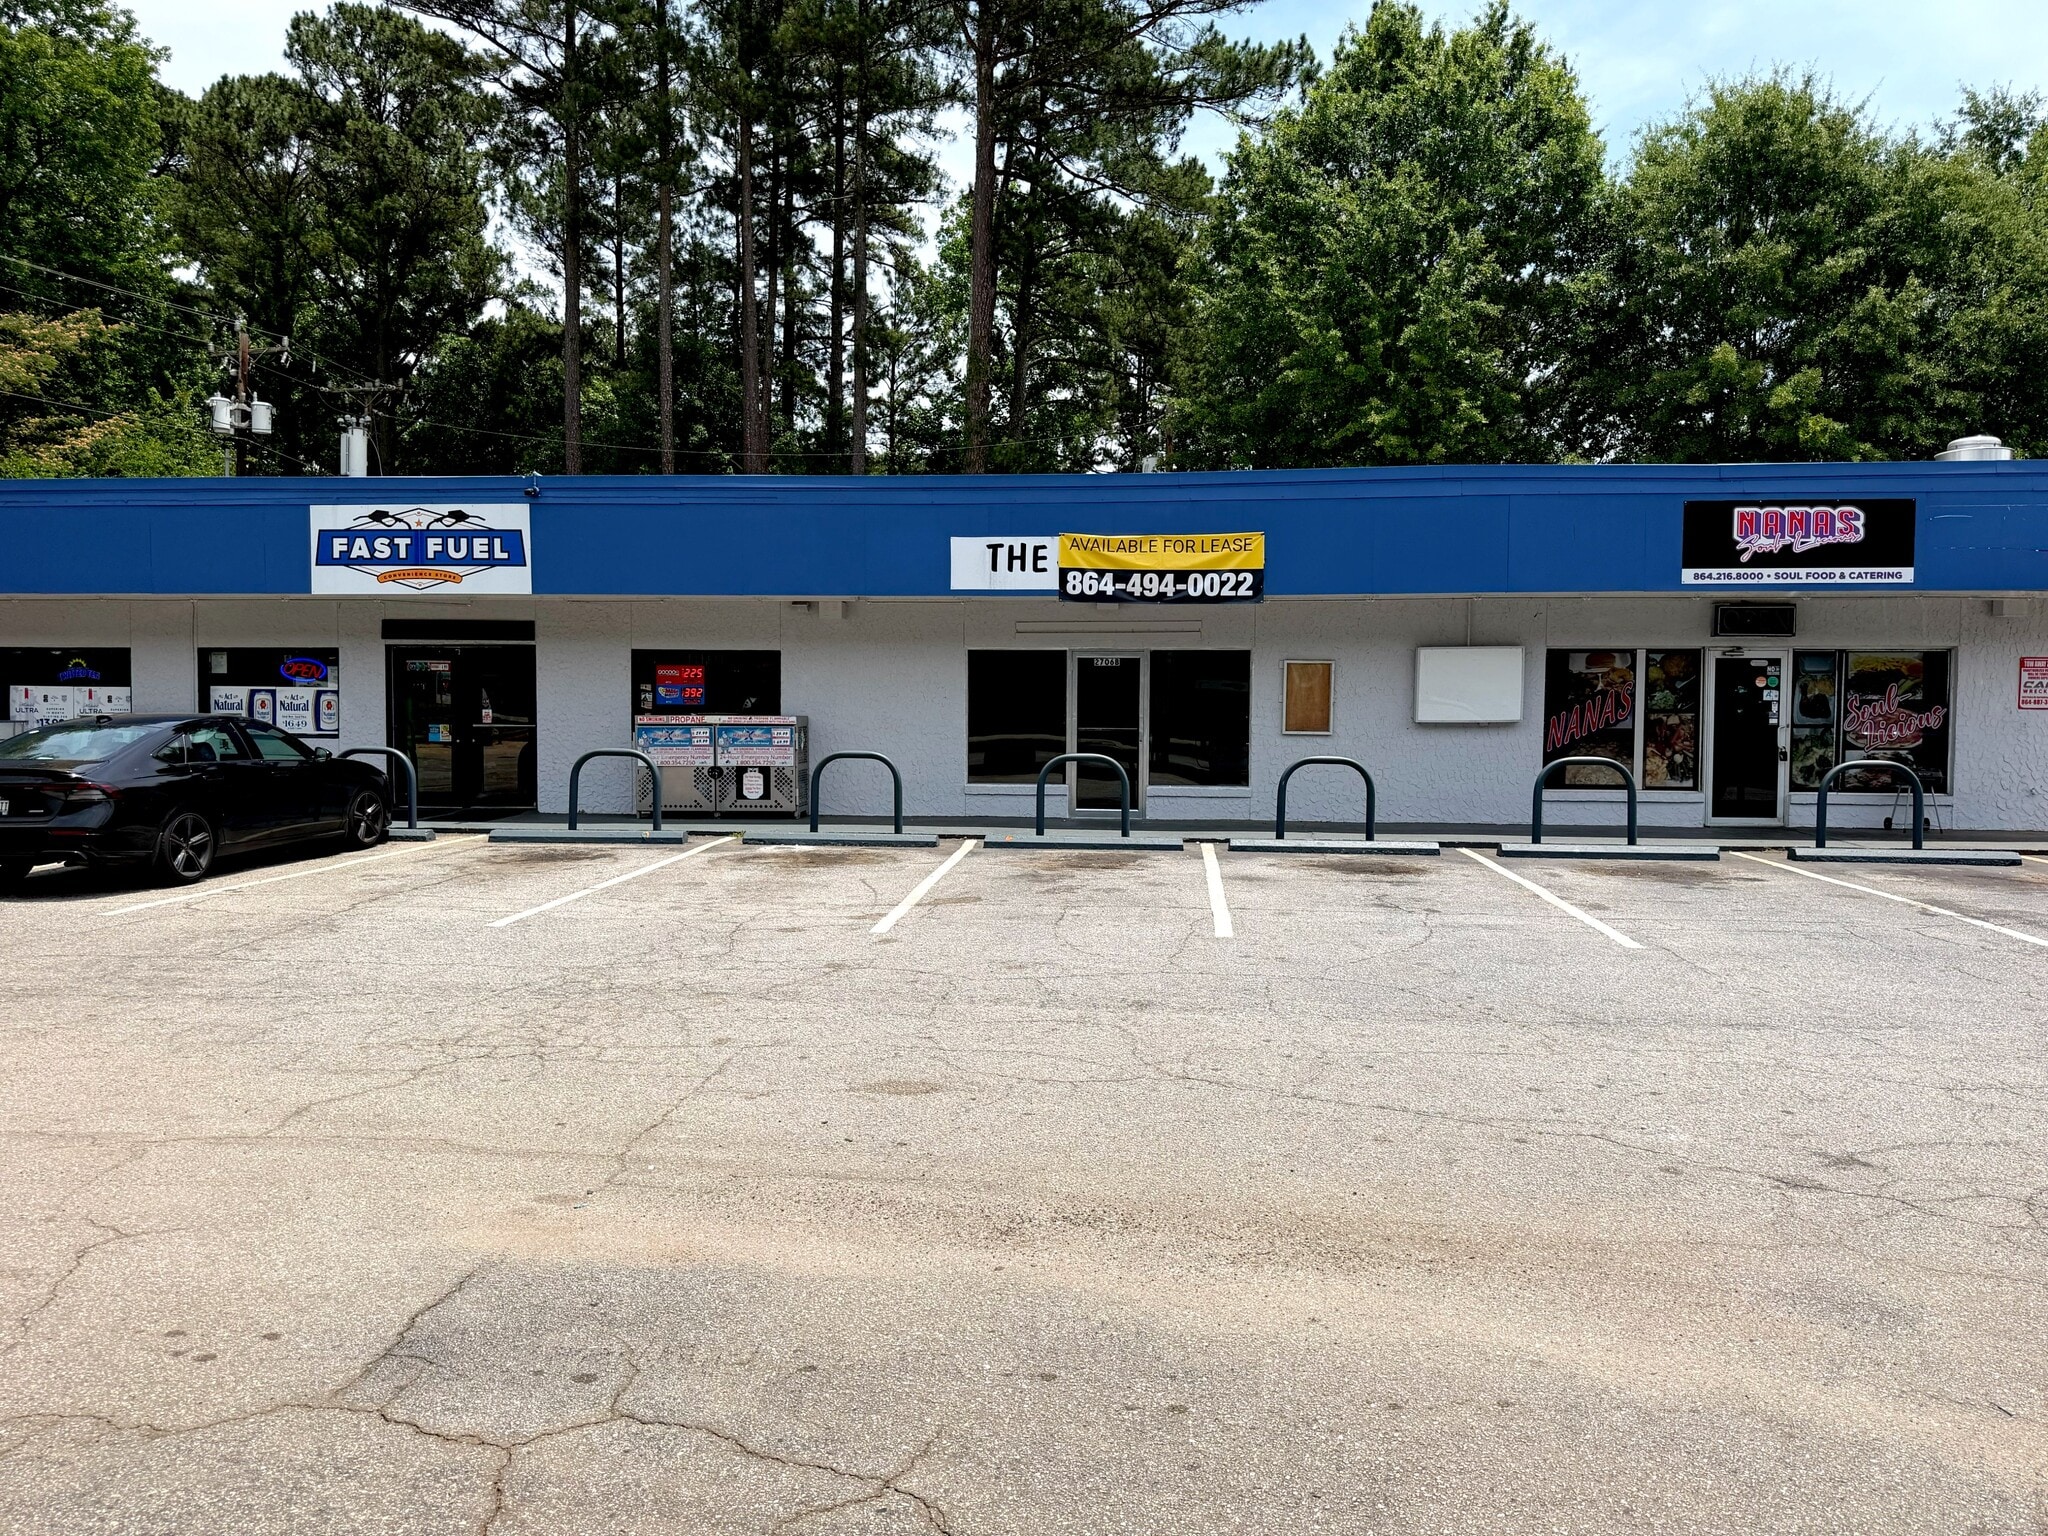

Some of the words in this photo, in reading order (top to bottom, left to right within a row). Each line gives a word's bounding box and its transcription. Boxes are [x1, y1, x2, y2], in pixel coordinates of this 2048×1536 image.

[1737, 510, 1861, 539] NANAS
[332, 537, 412, 559] FAST
[426, 537, 509, 559] FUEL
[1069, 537, 1158, 554] AVAILABLE
[1163, 539, 1195, 554] FOR
[1201, 537, 1253, 553] LEASE
[986, 542, 1048, 573] THE
[383, 572, 432, 580] CONVENIENCE
[435, 572, 456, 580] STORE
[1066, 571, 1253, 597] 864-494-0022
[1693, 572, 1763, 581] 864.216.8000
[1774, 571, 1803, 580] SOUL
[1805, 571, 1836, 580] FOOD
[1838, 571, 1846, 580] &
[1848, 571, 1903, 580] CATERING
[284, 662, 322, 678] OPEN
[684, 668, 703, 678] 225
[684, 688, 703, 697] 392
[214, 699, 244, 711] Natural
[280, 700, 309, 712] Natural
[1546, 681, 1634, 752] NANAS
[1861, 706, 1947, 752] Licious
